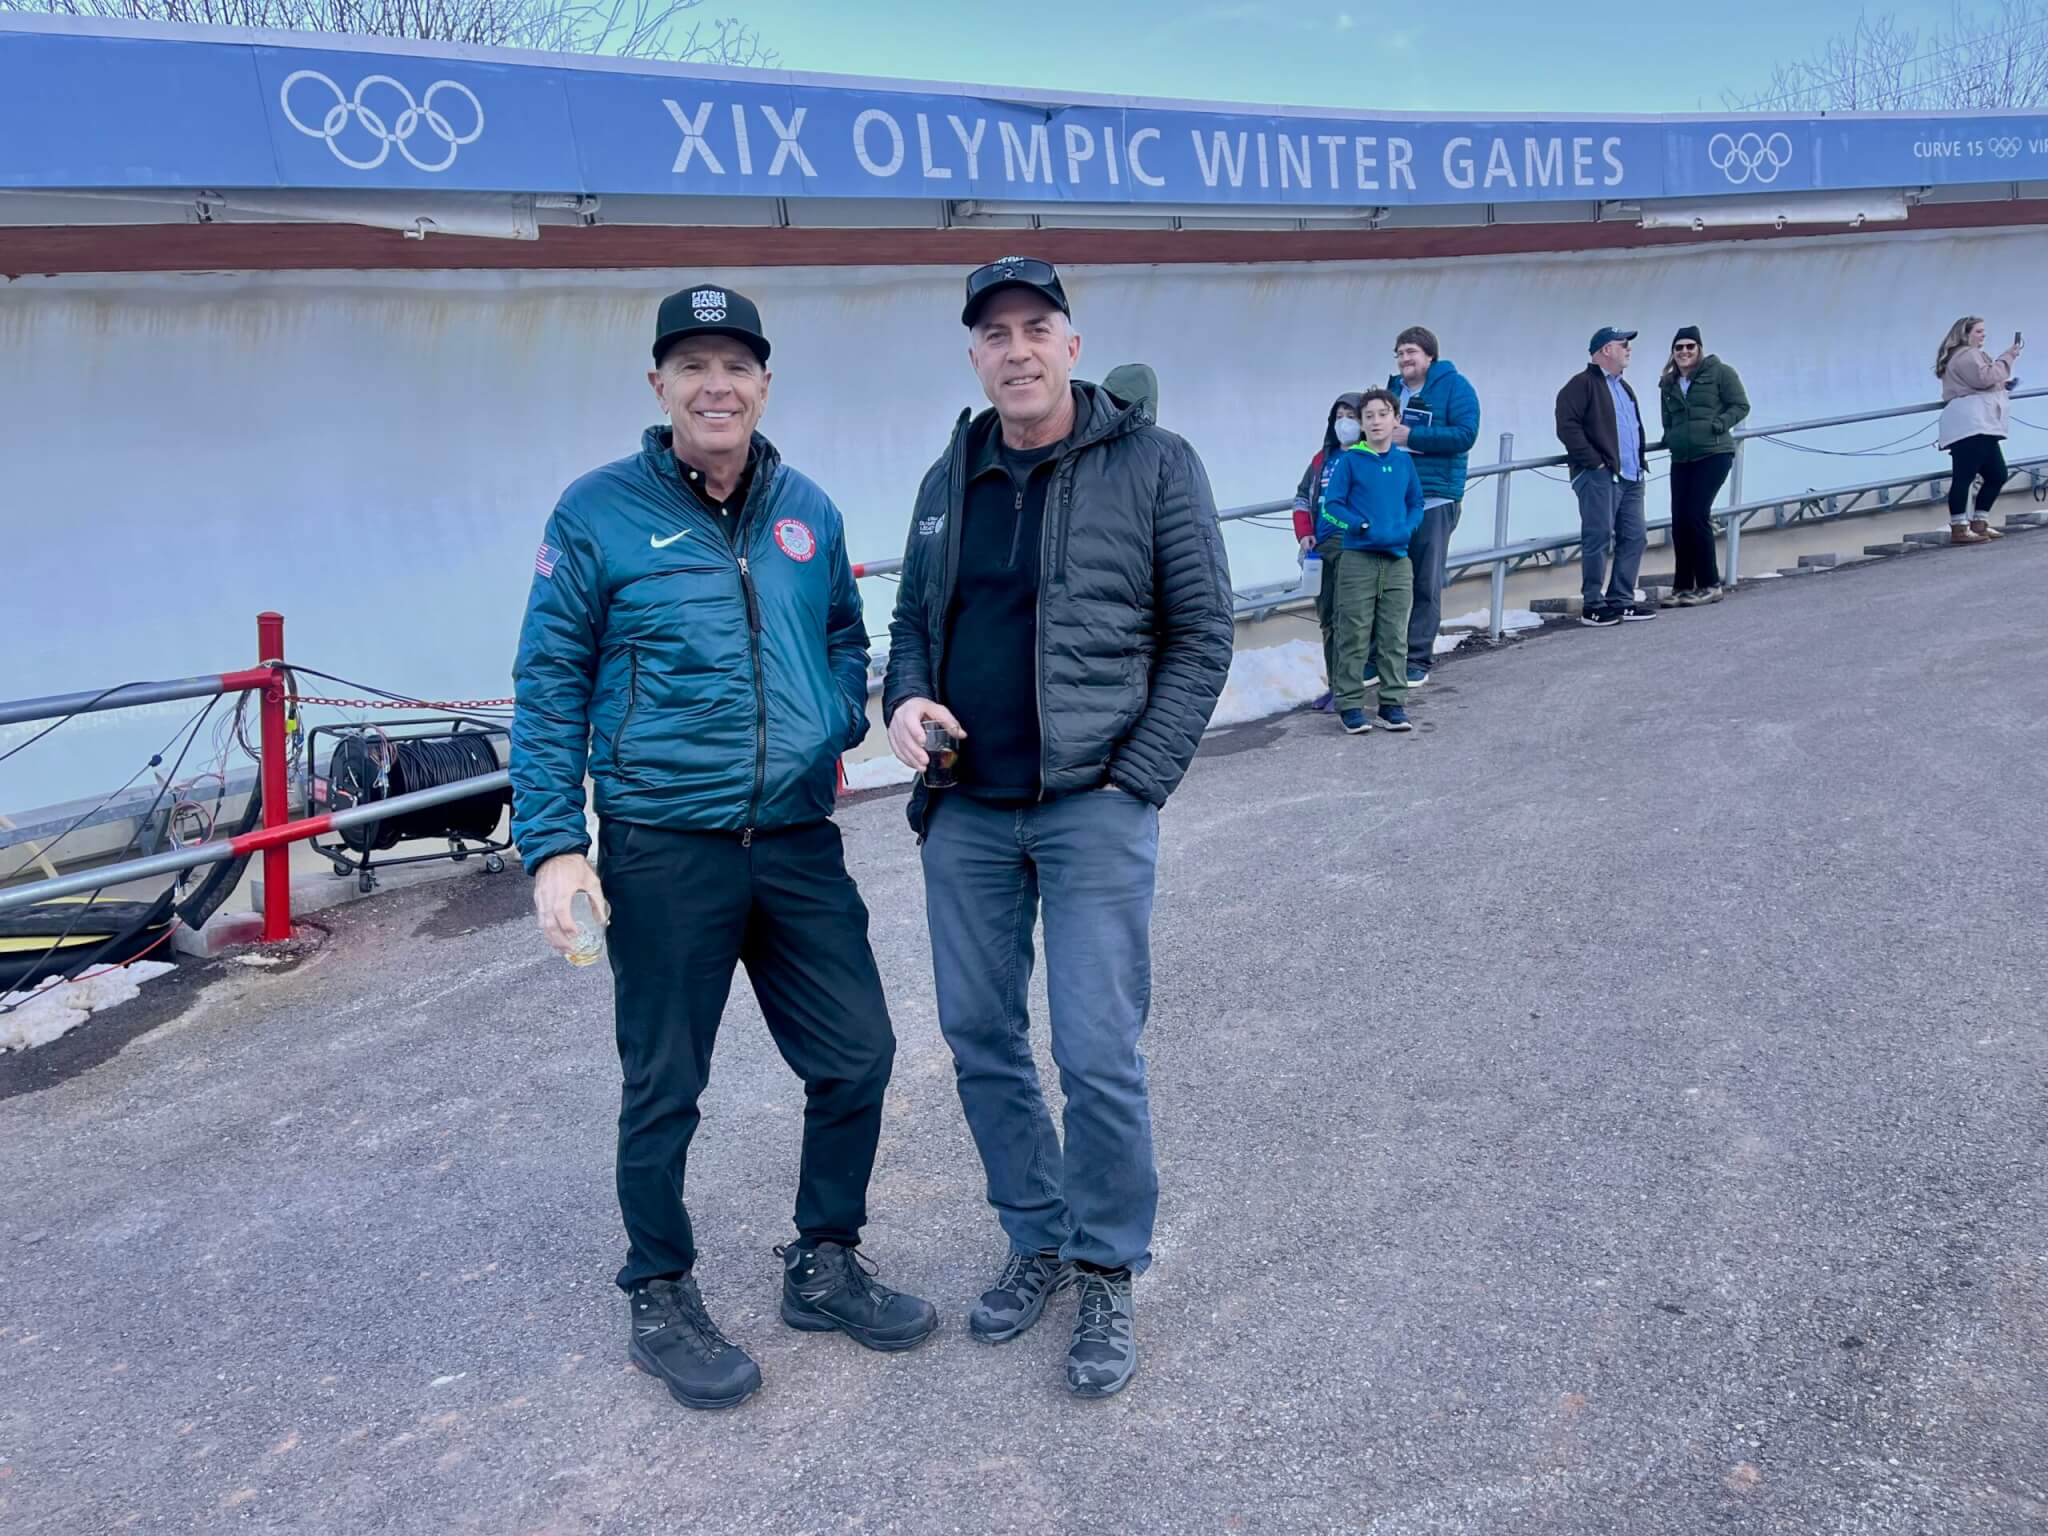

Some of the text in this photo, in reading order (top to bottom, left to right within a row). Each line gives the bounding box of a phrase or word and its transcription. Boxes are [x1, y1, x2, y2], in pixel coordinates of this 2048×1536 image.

[662, 99, 1624, 190] XIX OLYMPIC WINTER GAMES
[1913, 140, 1961, 158] CURVE
[1967, 140, 1984, 157] 15
